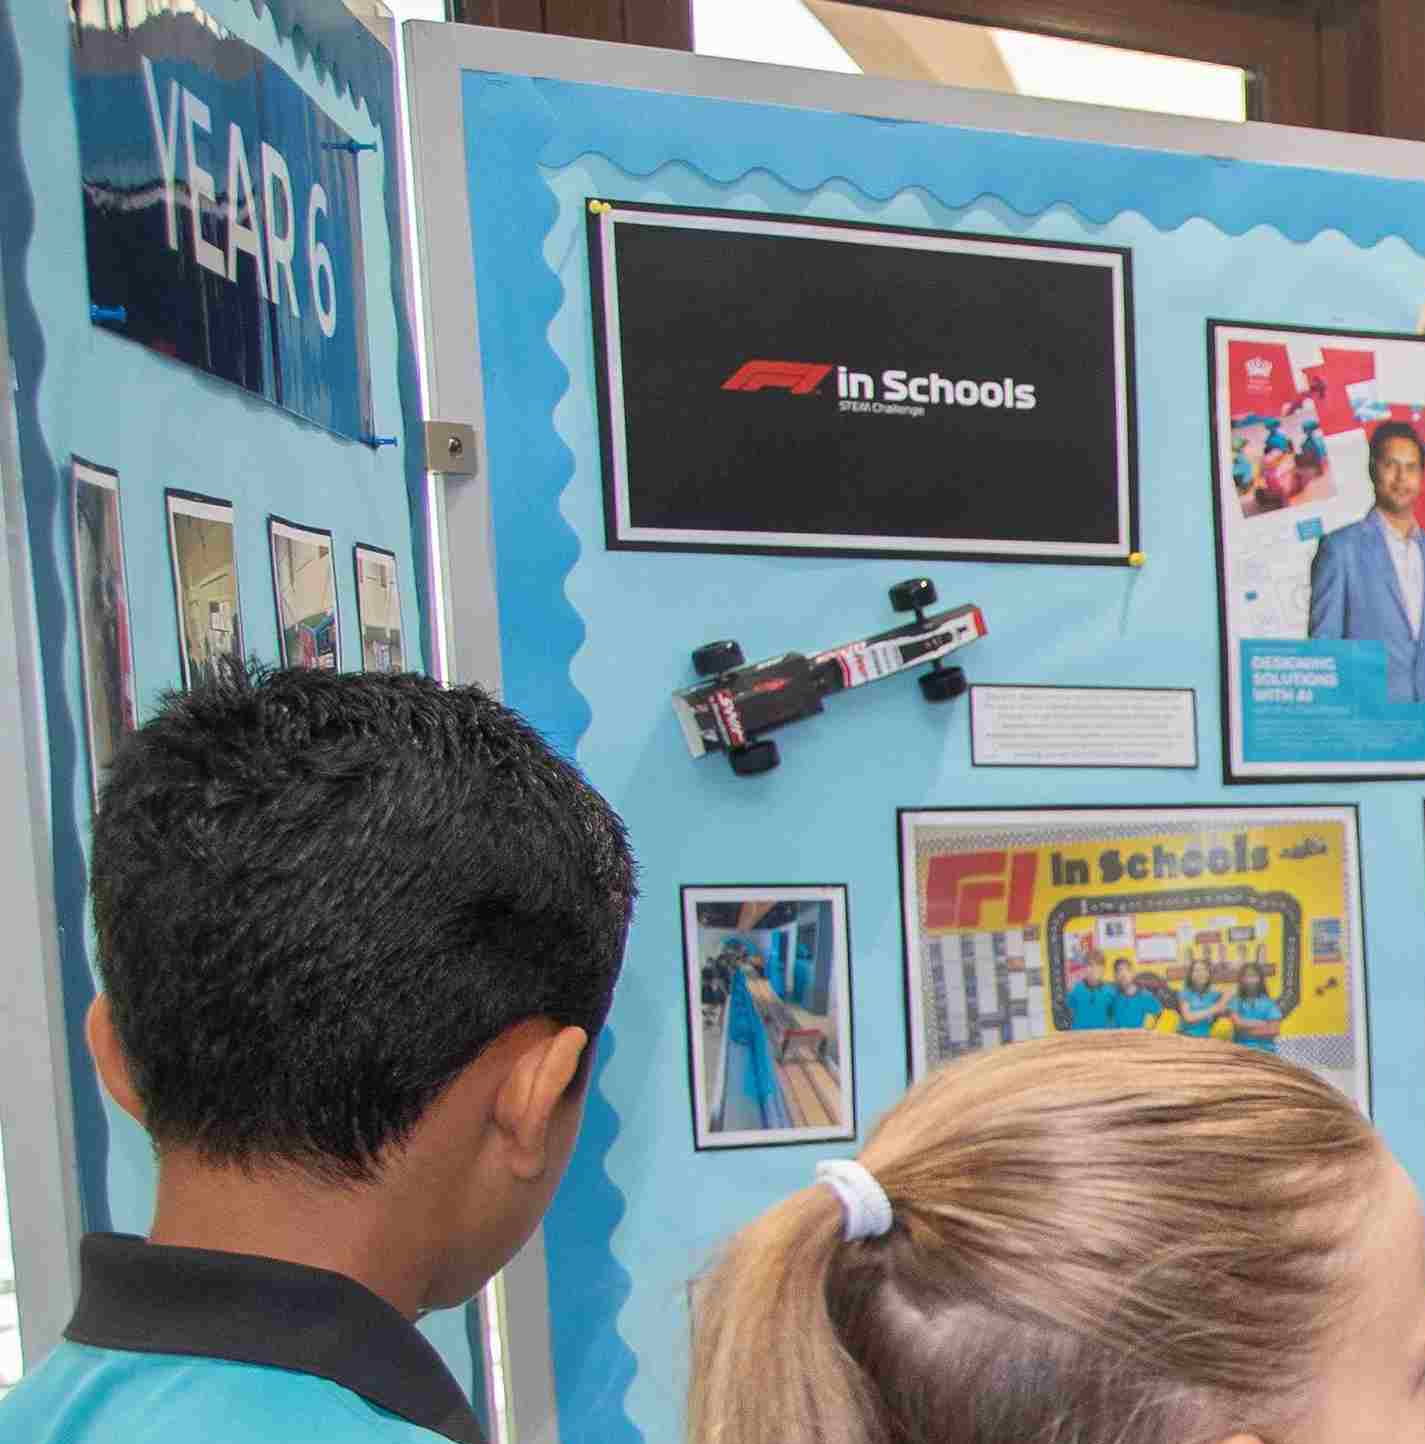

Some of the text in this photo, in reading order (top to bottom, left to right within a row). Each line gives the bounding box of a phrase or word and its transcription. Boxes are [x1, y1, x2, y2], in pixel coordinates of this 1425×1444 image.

[141, 54, 336, 338] YEAR 6
[837, 366, 874, 399] in
[882, 369, 1037, 410] Schools
[838, 400, 926, 418] STEM Challenge
[1099, 834, 1269, 883] Schools
